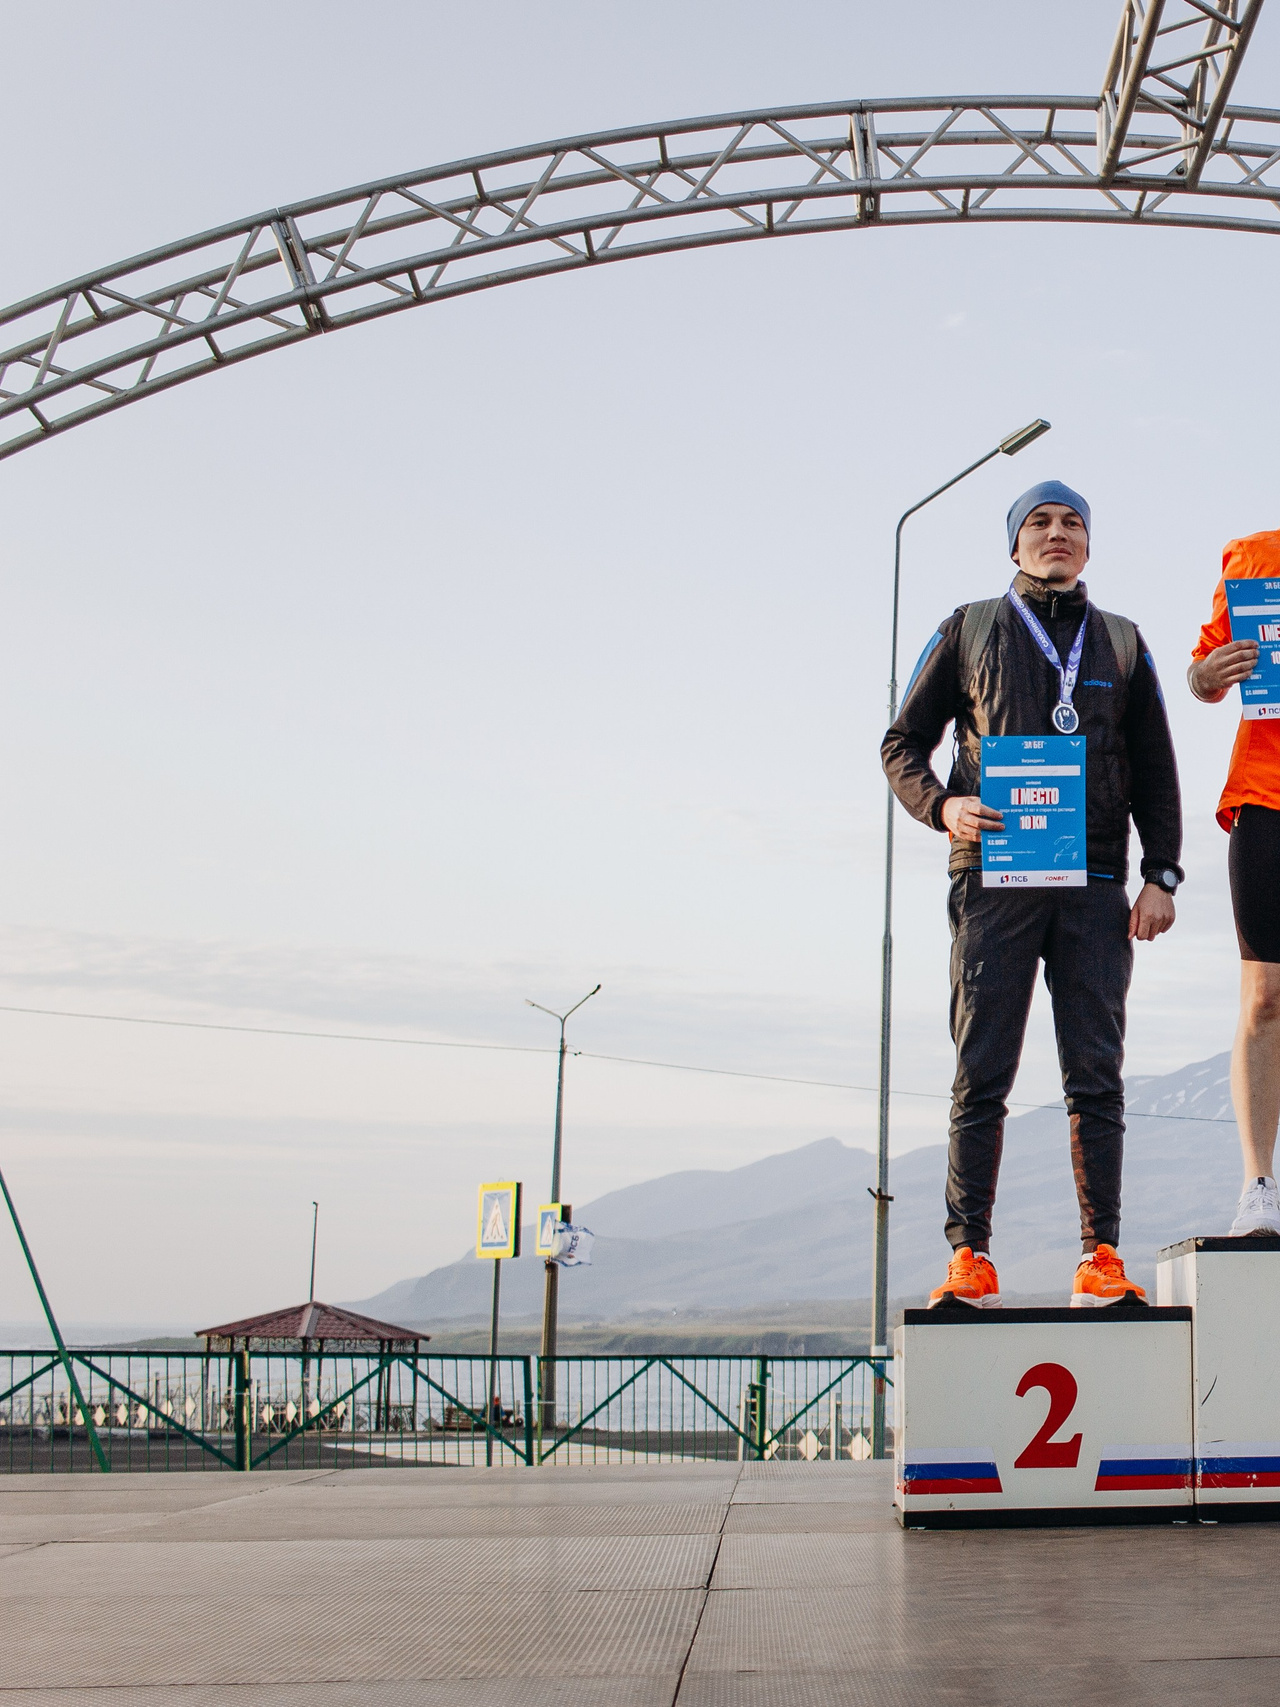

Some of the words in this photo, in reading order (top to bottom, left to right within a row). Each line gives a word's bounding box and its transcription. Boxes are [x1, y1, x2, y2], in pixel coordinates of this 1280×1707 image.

[1271, 651, 1280, 664] 10
[1083, 680, 1106, 688] adidas
[1020, 787, 1060, 806] МЕСТО
[1020, 816, 1031, 829] 10
[1033, 815, 1047, 829] КМ
[1014, 1363, 1082, 1468] 2
